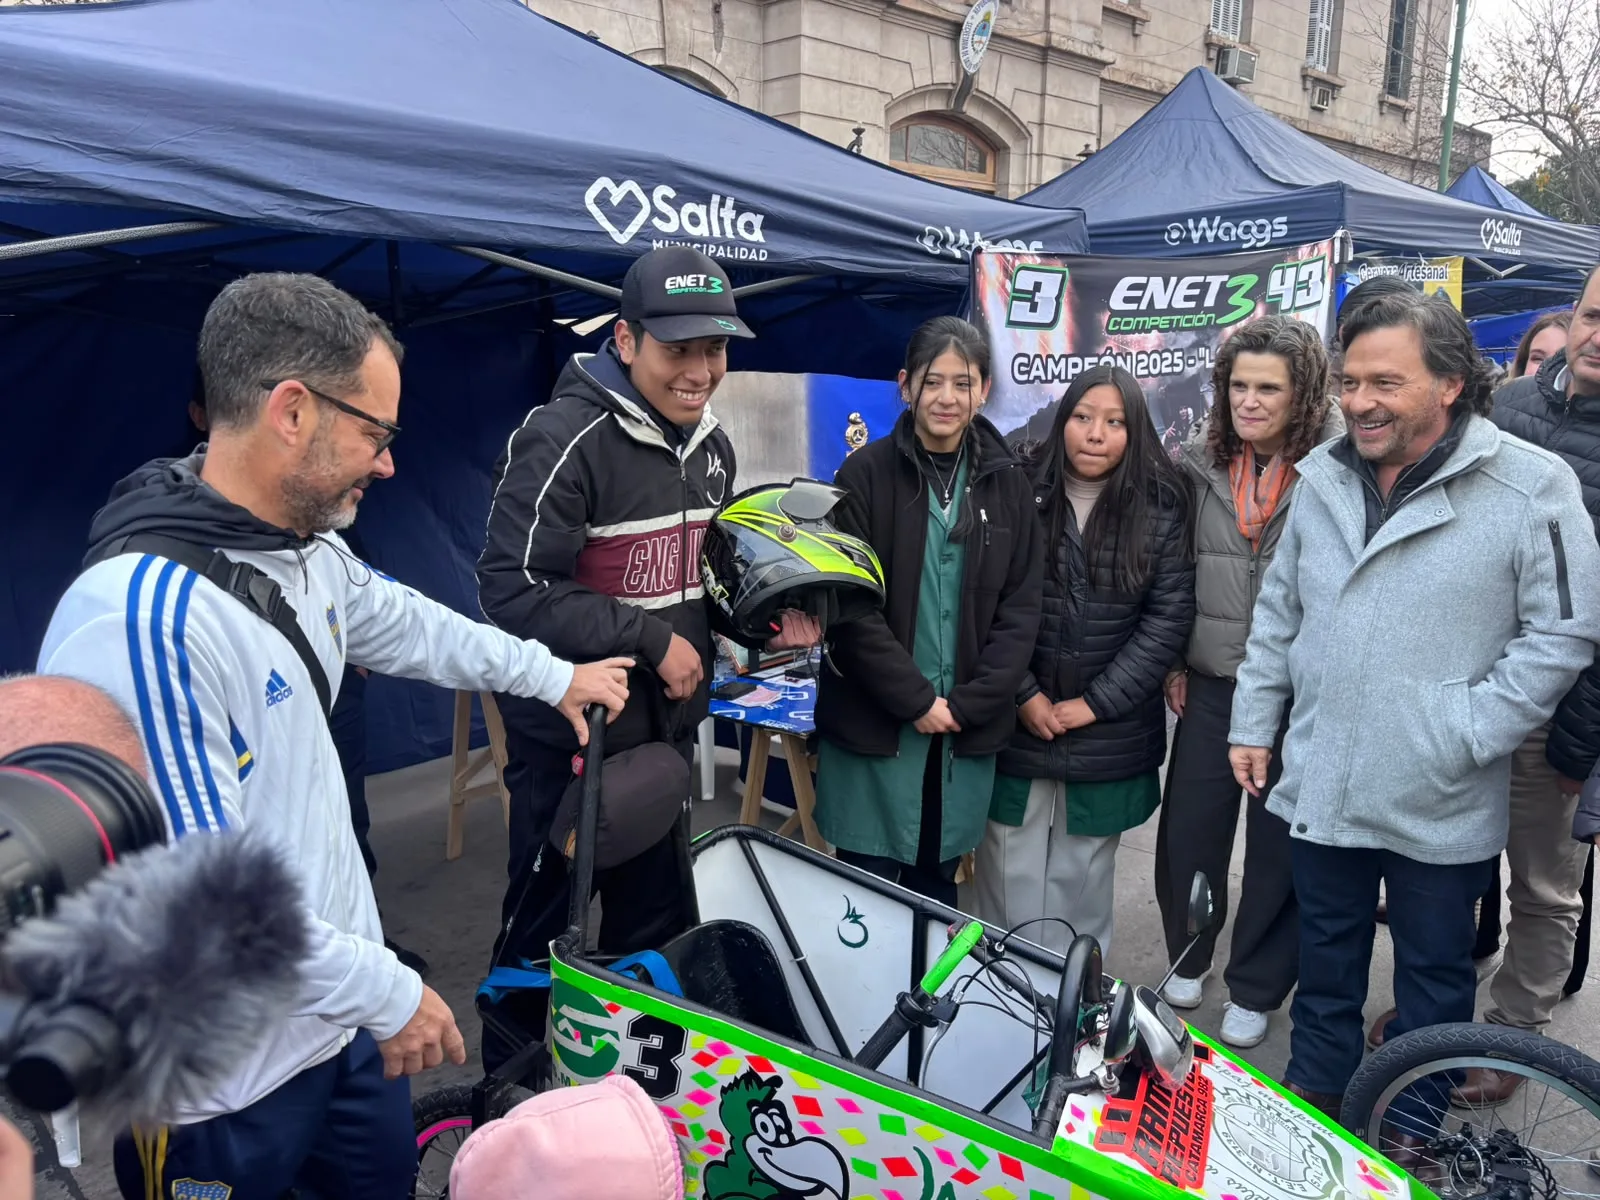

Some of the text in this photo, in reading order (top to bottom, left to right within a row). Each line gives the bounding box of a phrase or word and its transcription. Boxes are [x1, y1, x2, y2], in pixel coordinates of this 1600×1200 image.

[651, 184, 766, 243] Salta
[1494, 220, 1522, 246] Salta
[665, 274, 724, 294] ENET 3
[1005, 263, 1069, 330] 3
[1109, 273, 1259, 324] ENET 3
[1266, 256, 1327, 314] 43
[1137, 351, 1184, 377] 2025
[621, 1012, 688, 1101] 3
[1185, 1075, 1209, 1182] CATAMARCA 982
[1310, 1153, 1325, 1188] SALTA
